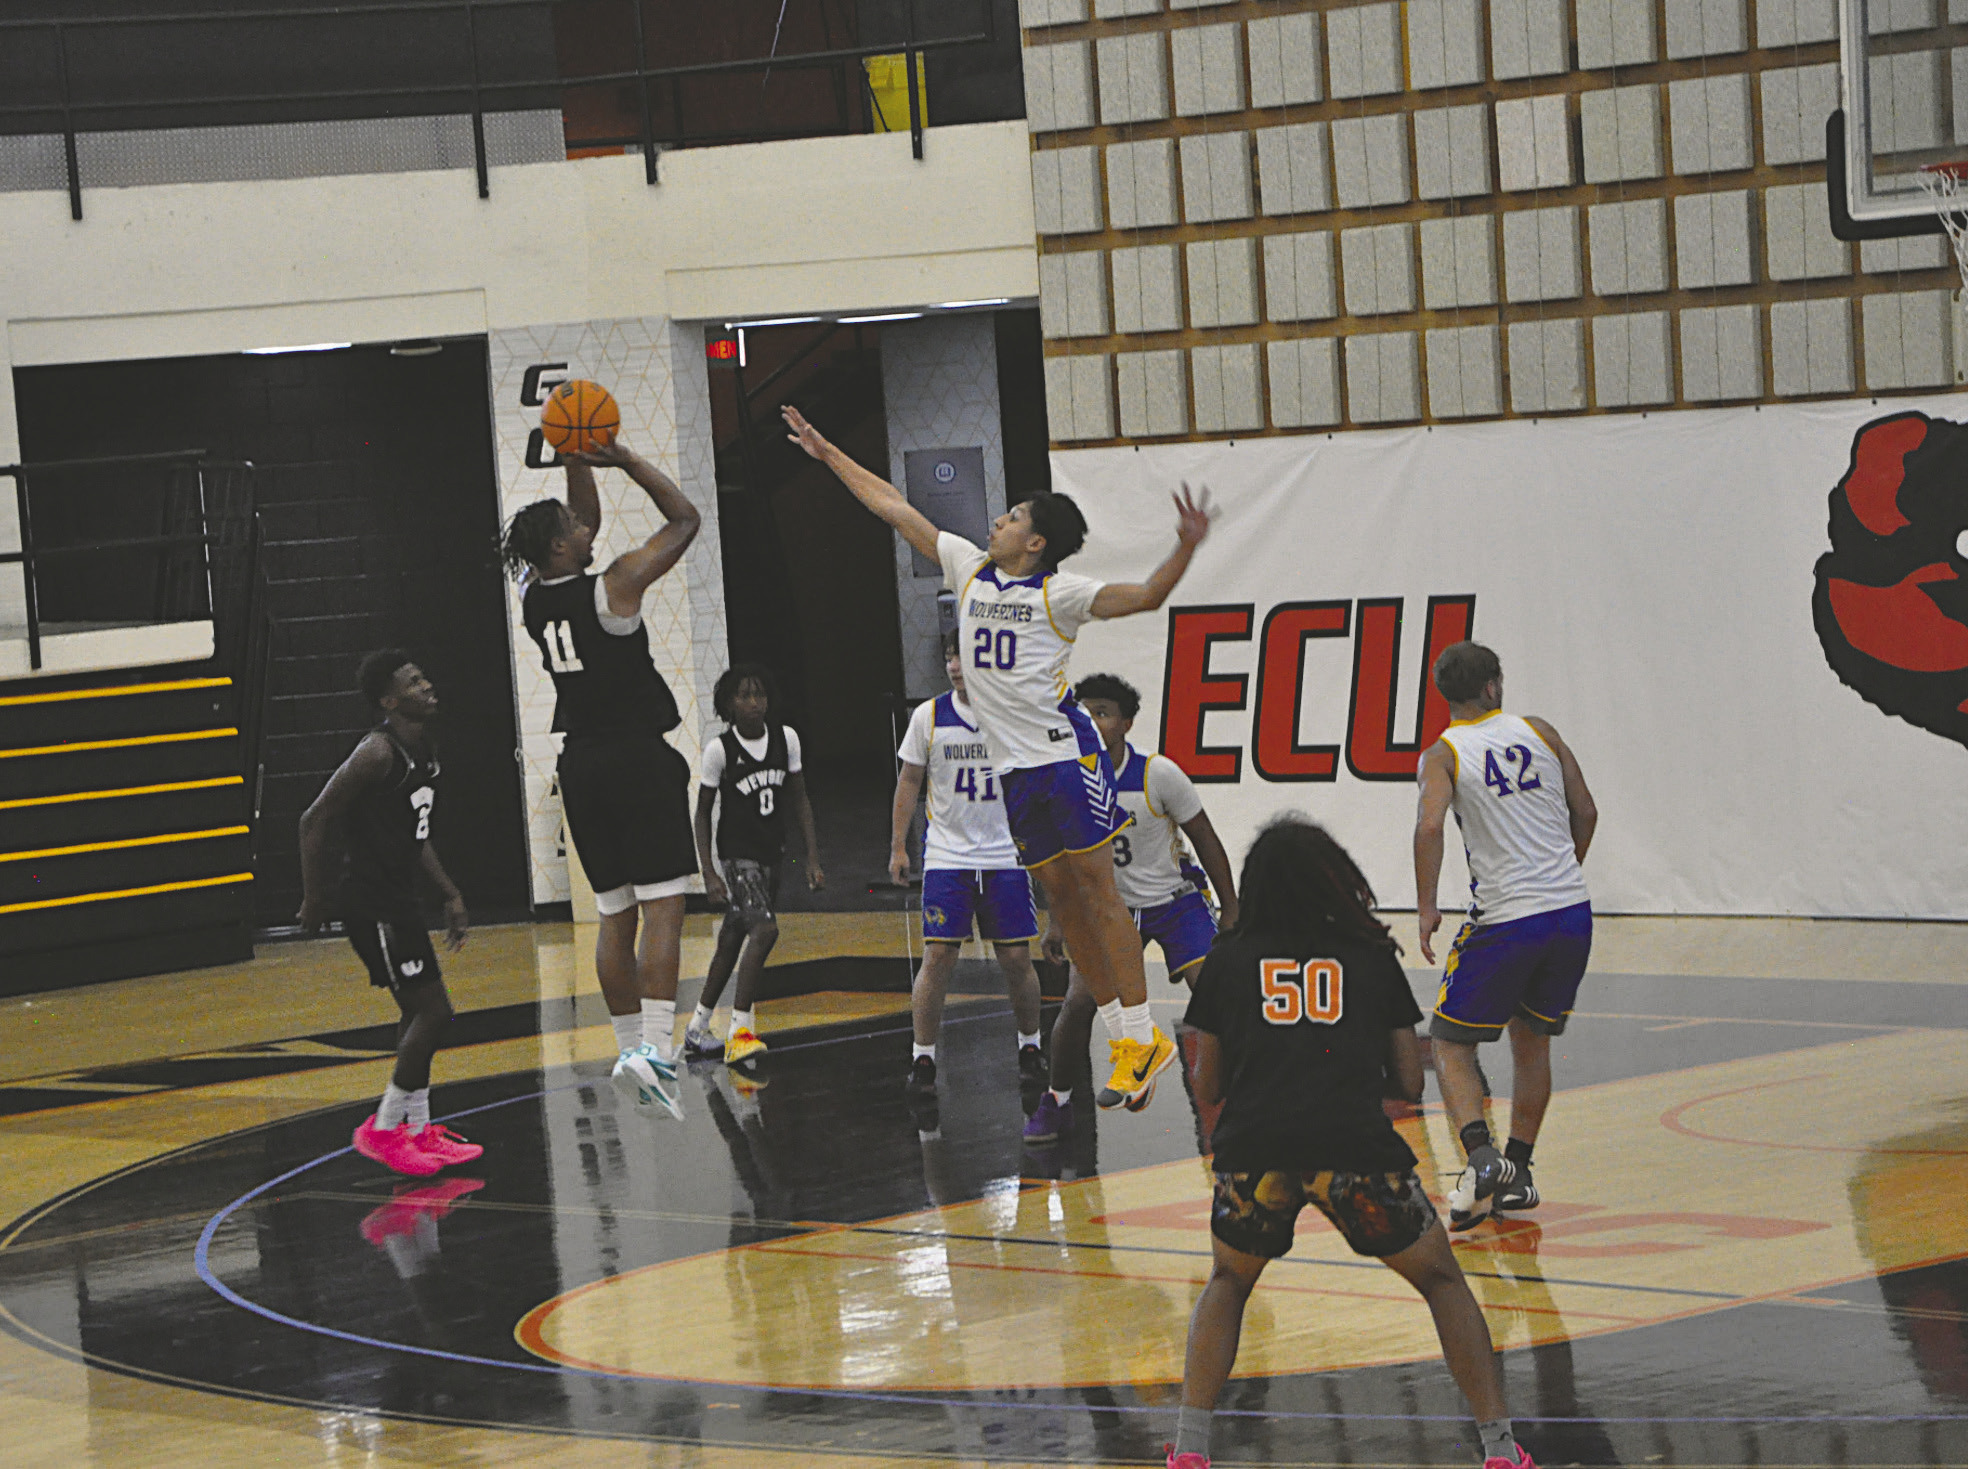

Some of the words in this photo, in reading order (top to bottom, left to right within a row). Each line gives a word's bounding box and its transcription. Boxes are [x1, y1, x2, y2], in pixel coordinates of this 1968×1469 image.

[968, 599, 1033, 622] WOLVERINES
[543, 620, 584, 673] 11
[974, 628, 1016, 670] 20
[1158, 593, 1477, 784] ECU
[954, 767, 998, 801] 41
[1485, 744, 1541, 797] 42
[759, 788, 774, 816] 0
[1260, 957, 1343, 1025] 50
